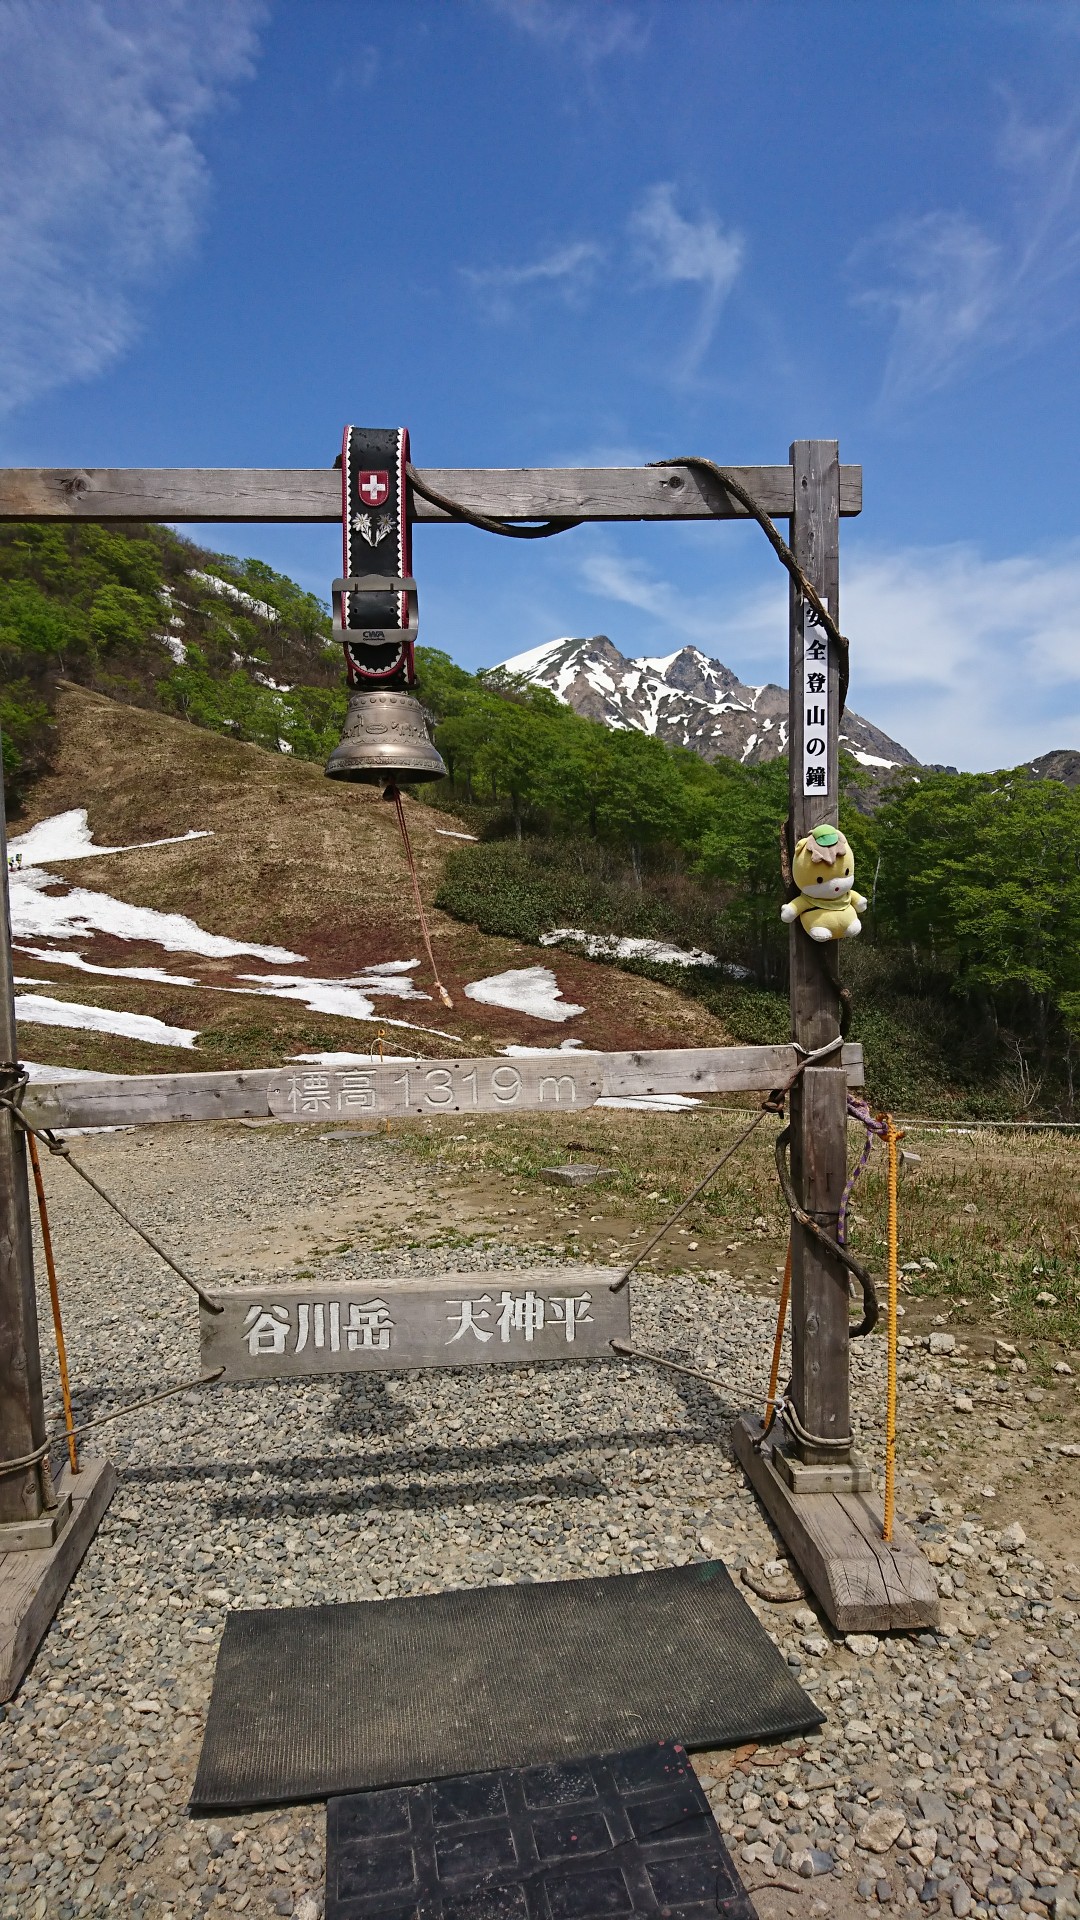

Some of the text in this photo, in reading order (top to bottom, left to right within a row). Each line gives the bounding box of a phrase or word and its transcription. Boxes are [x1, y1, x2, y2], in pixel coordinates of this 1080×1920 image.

[287, 1070, 378, 1114] 標高
[394, 1065, 523, 1108] 1319
[242, 1290, 595, 1356] 谷川岳 天神平
